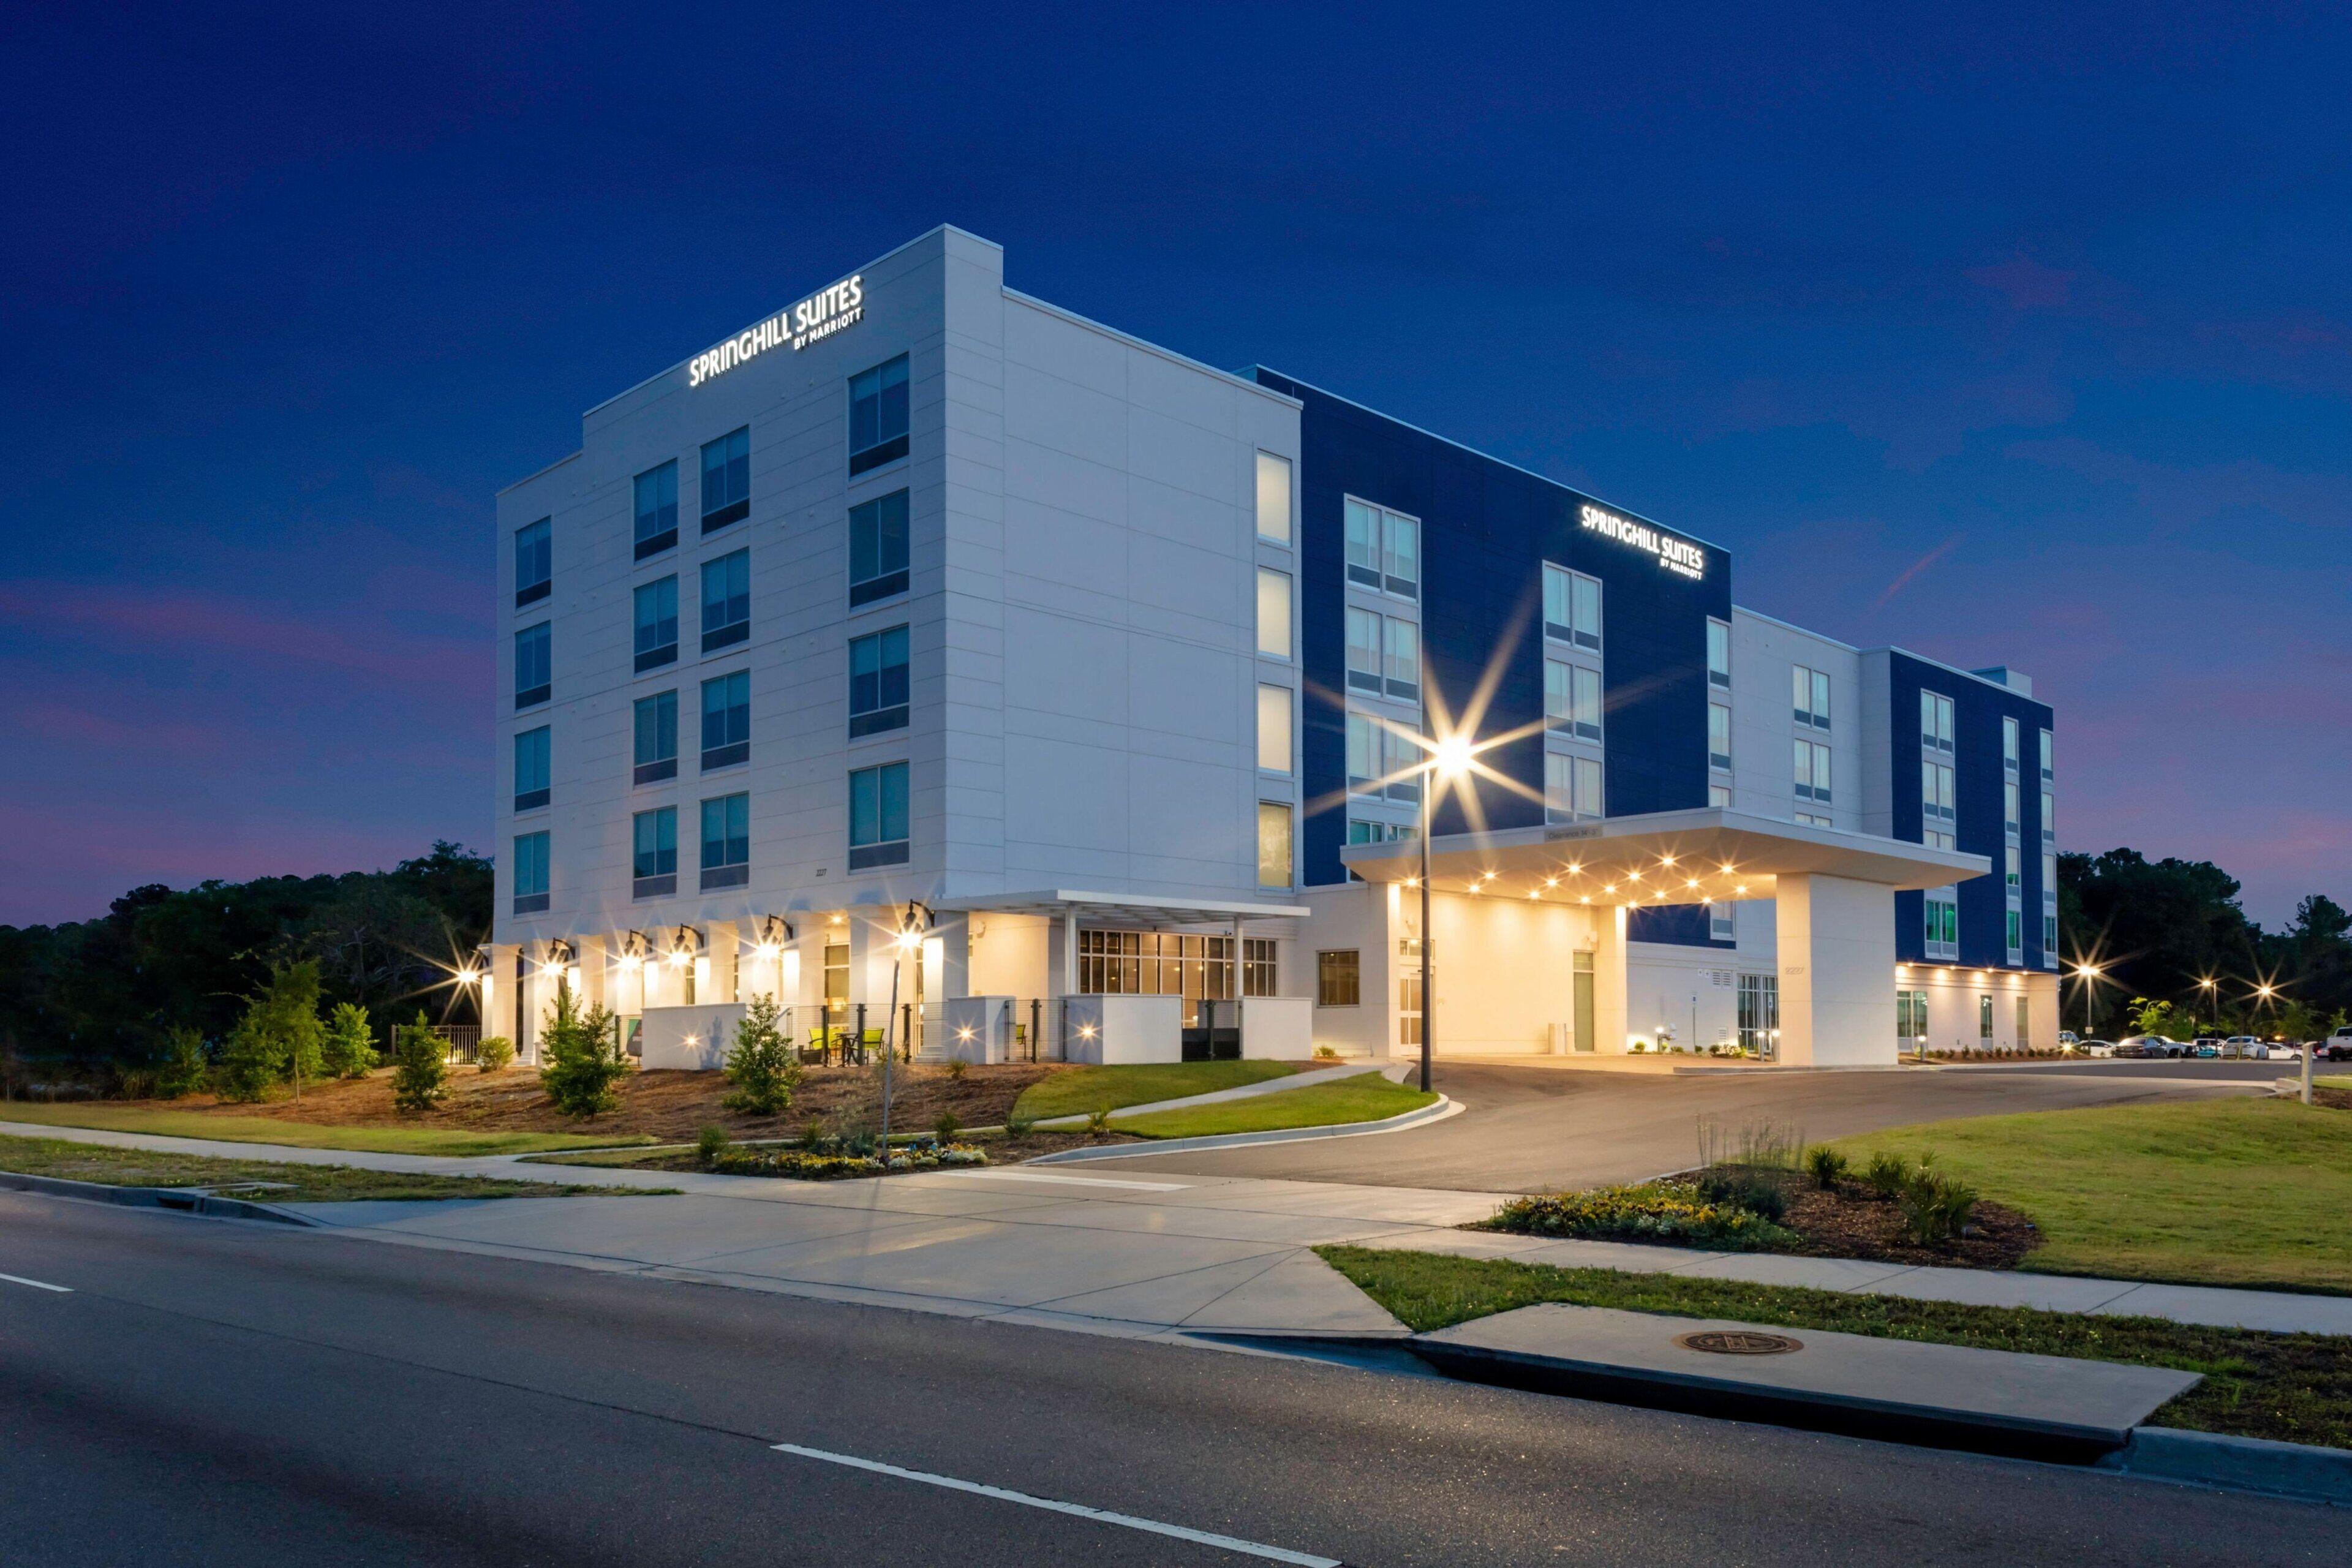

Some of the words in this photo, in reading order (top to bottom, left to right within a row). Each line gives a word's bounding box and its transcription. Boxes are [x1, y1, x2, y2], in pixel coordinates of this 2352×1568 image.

[690, 312, 792, 386] SPRINGHILL
[796, 275, 861, 333] SUITES
[794, 335, 807, 350] BY
[810, 307, 861, 342] MARRIOTT
[1582, 505, 1660, 554] SPRINGHILL
[1662, 537, 1703, 569] SUITES
[1660, 558, 1669, 567] BY
[1670, 562, 1702, 580] MARRIOTT
